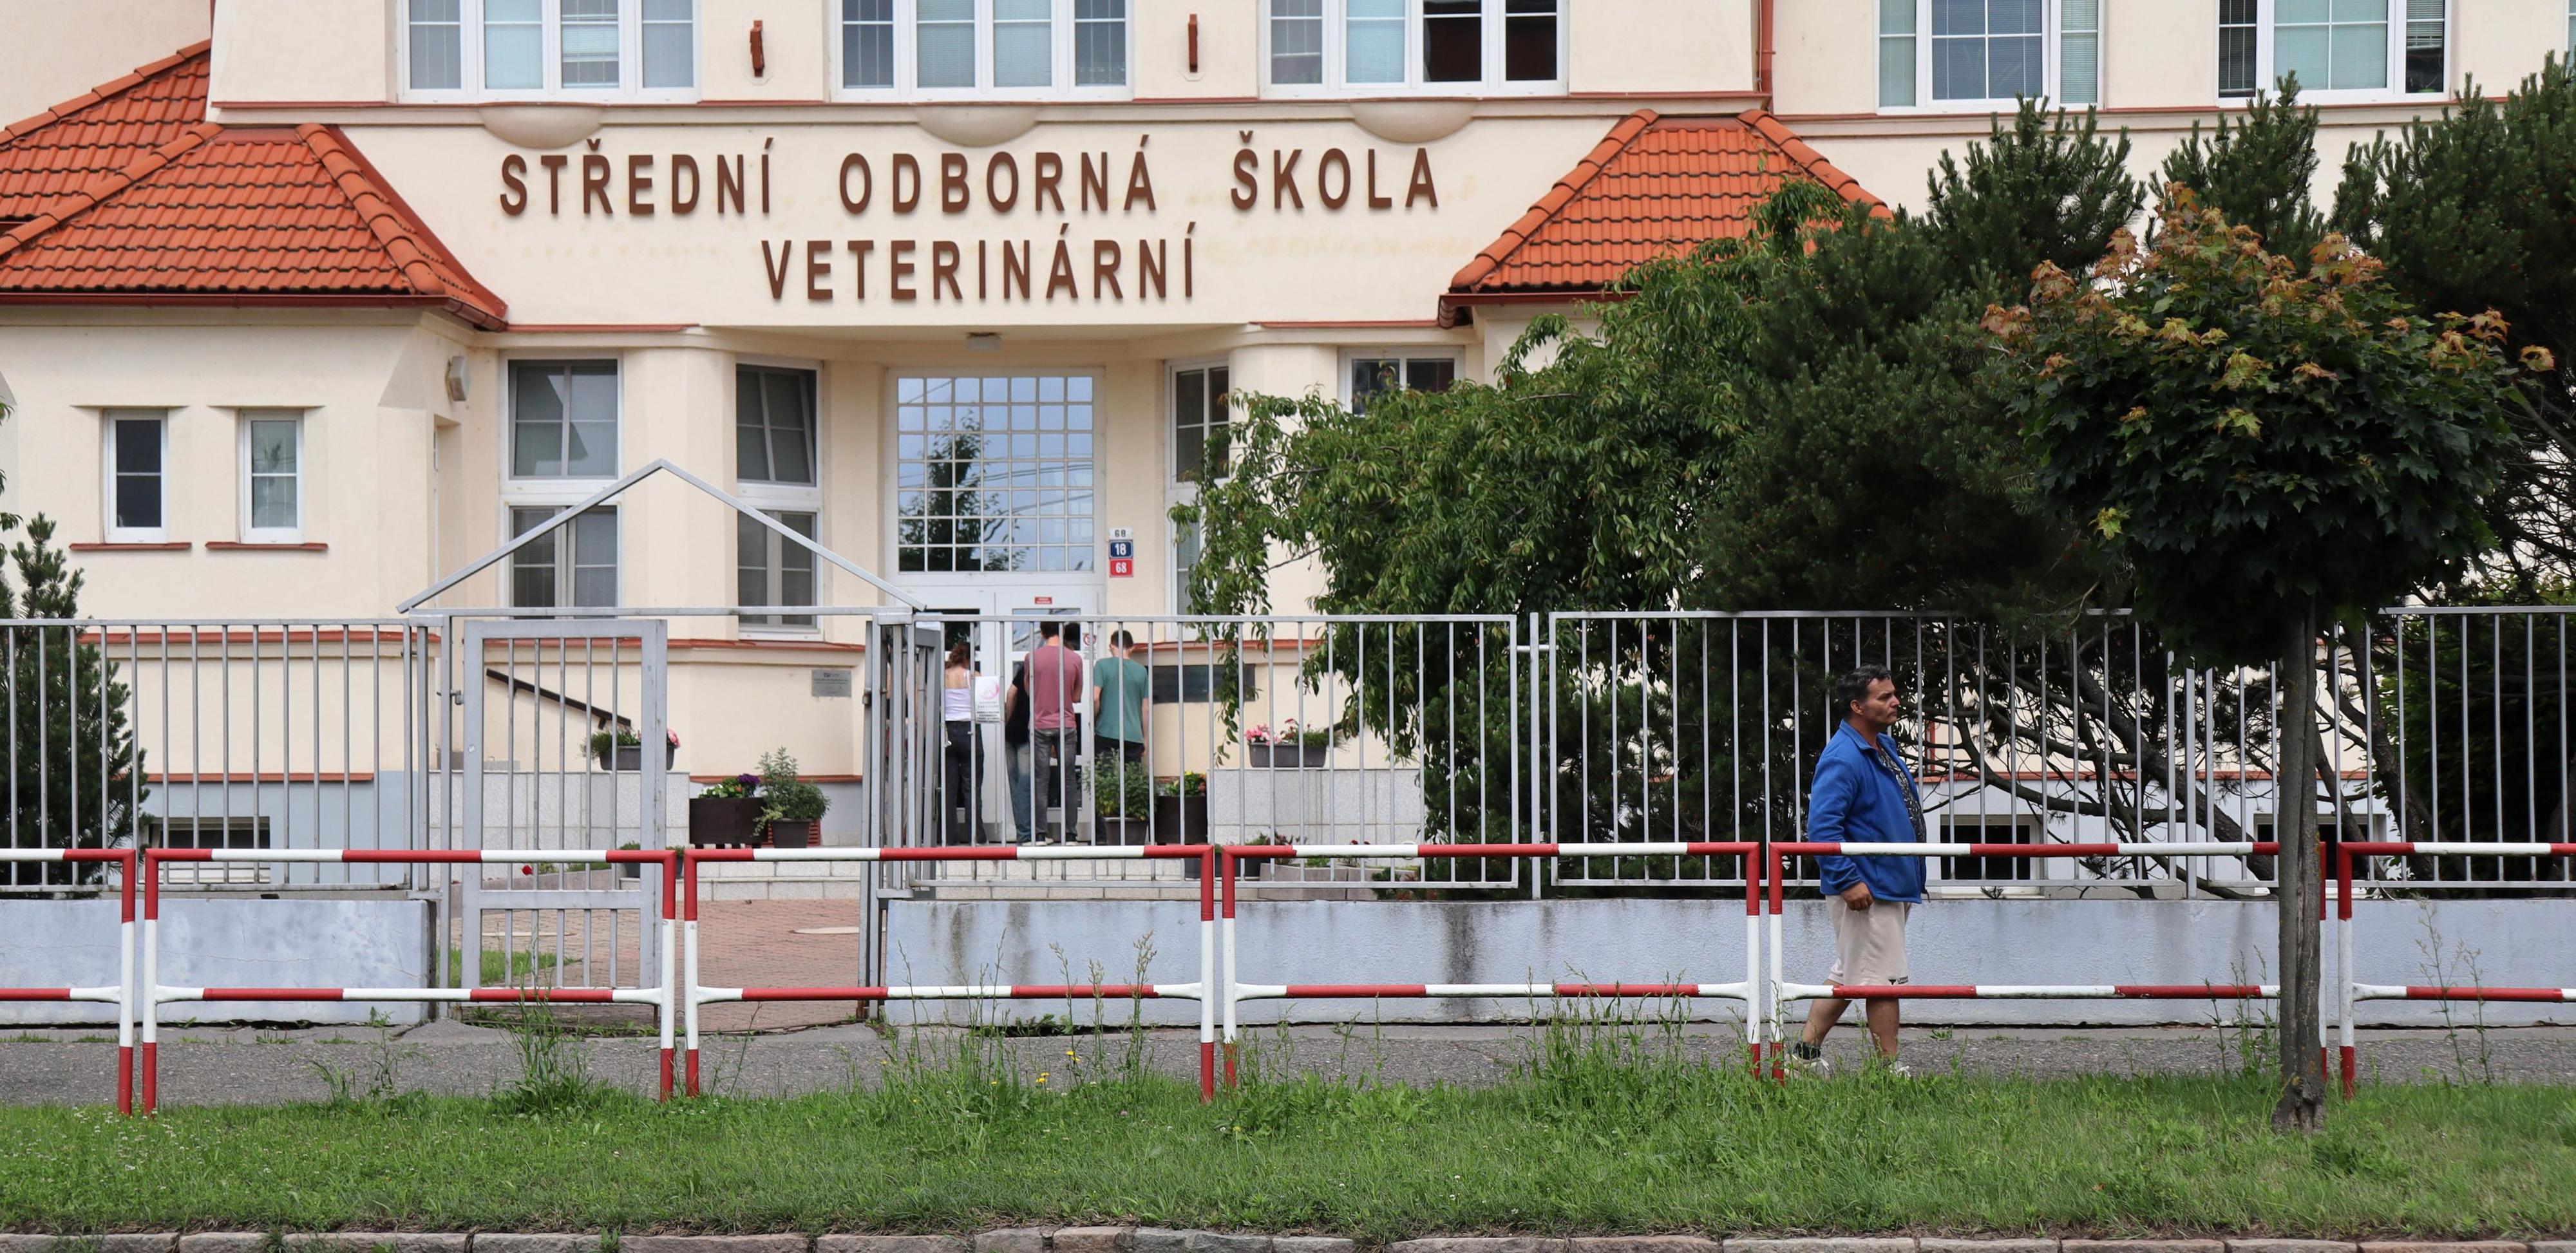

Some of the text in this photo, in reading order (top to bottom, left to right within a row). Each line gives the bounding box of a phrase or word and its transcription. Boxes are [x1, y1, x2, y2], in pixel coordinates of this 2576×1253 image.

[500, 131, 1438, 217] STŘEDNÍ ODBORNÁ ŠKOLA
[761, 221, 1197, 302] VETERINÁRNÍ
[1115, 543, 1126, 556] 18
[1115, 561, 1127, 574] 68
